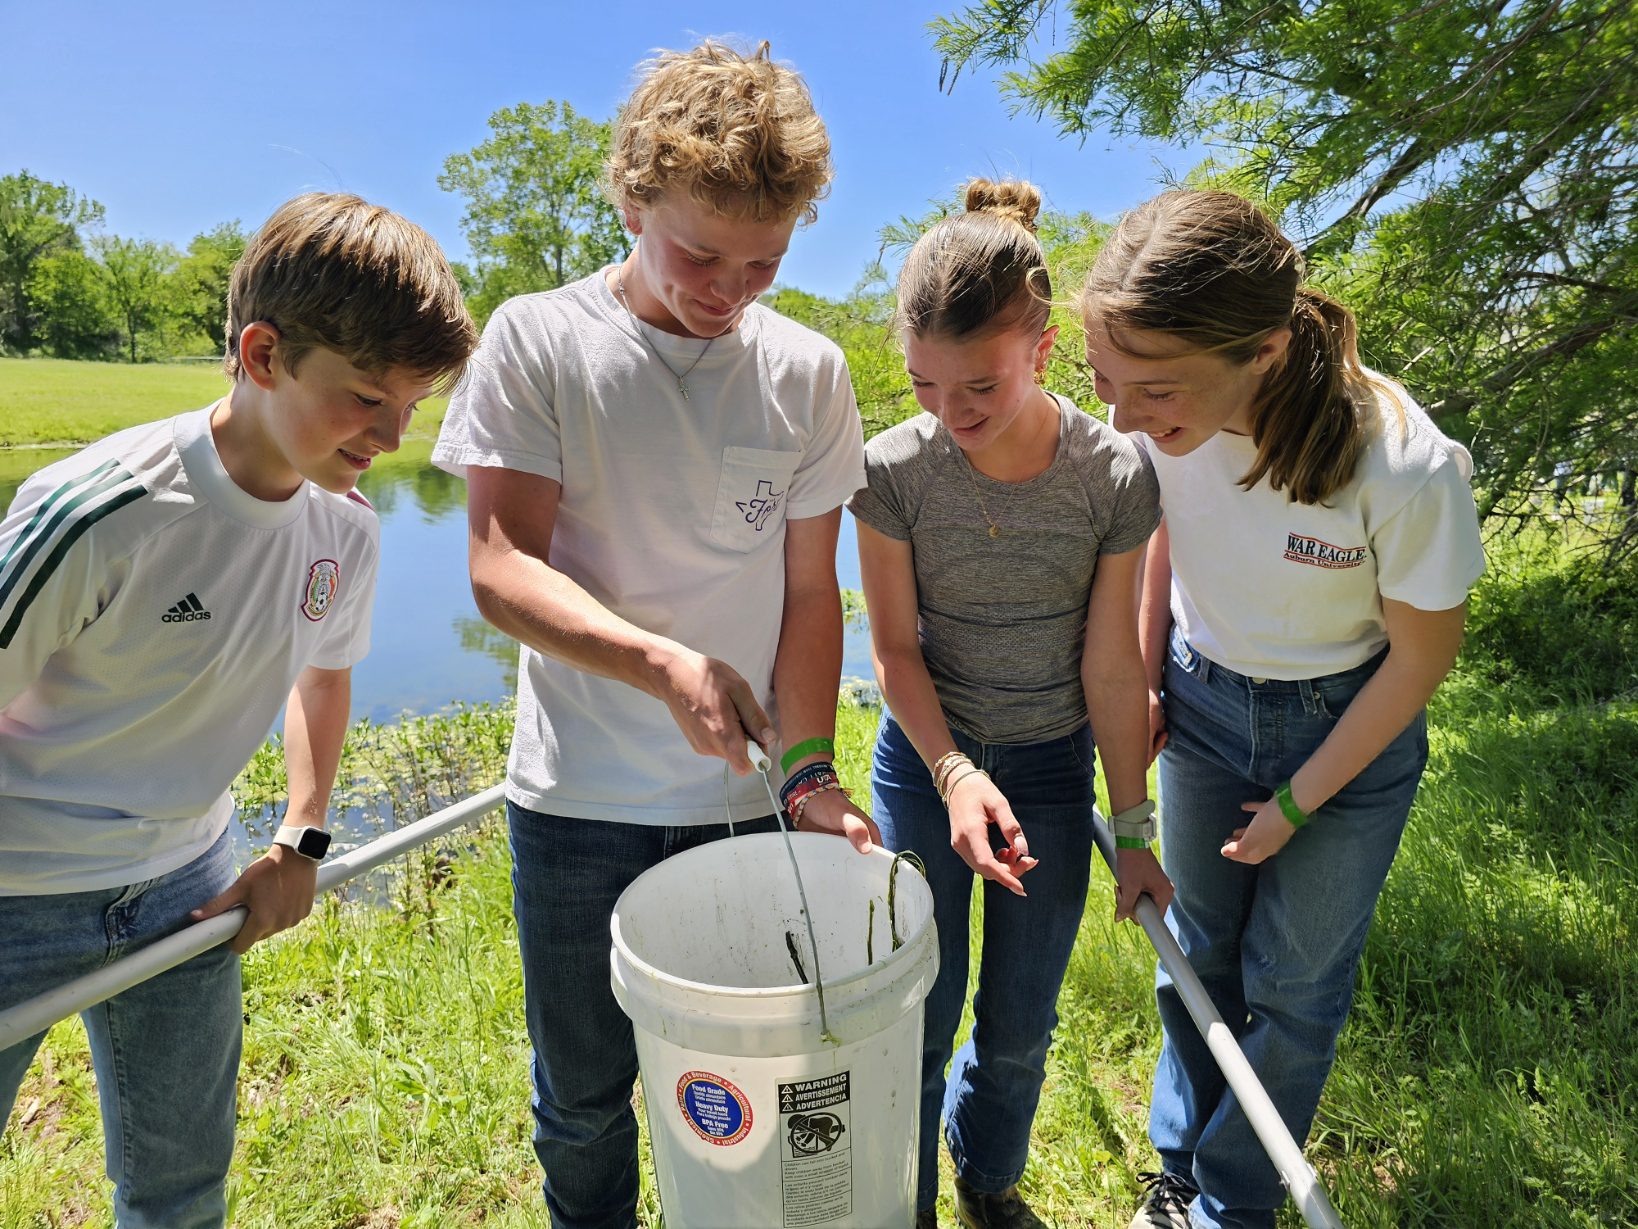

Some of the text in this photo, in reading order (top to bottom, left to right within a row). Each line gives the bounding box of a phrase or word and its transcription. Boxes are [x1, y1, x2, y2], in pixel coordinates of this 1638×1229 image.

[1287, 534, 1316, 555] WAR
[1284, 552, 1362, 569] Auburn University
[161, 610, 211, 623] adidas
[691, 1071, 722, 1083] Beverage
[795, 1073, 847, 1092] WARNING
[691, 1083, 726, 1095] Food Grade
[795, 1083, 847, 1102] AVERTISSEMENT
[695, 1101, 713, 1111] Heavy
[713, 1103, 729, 1113] Duty
[728, 1084, 752, 1121] Agricultural
[796, 1093, 847, 1111] ADVERTENCIA
[701, 1118, 714, 1127] BPA
[722, 1128, 748, 1146] Industrial
